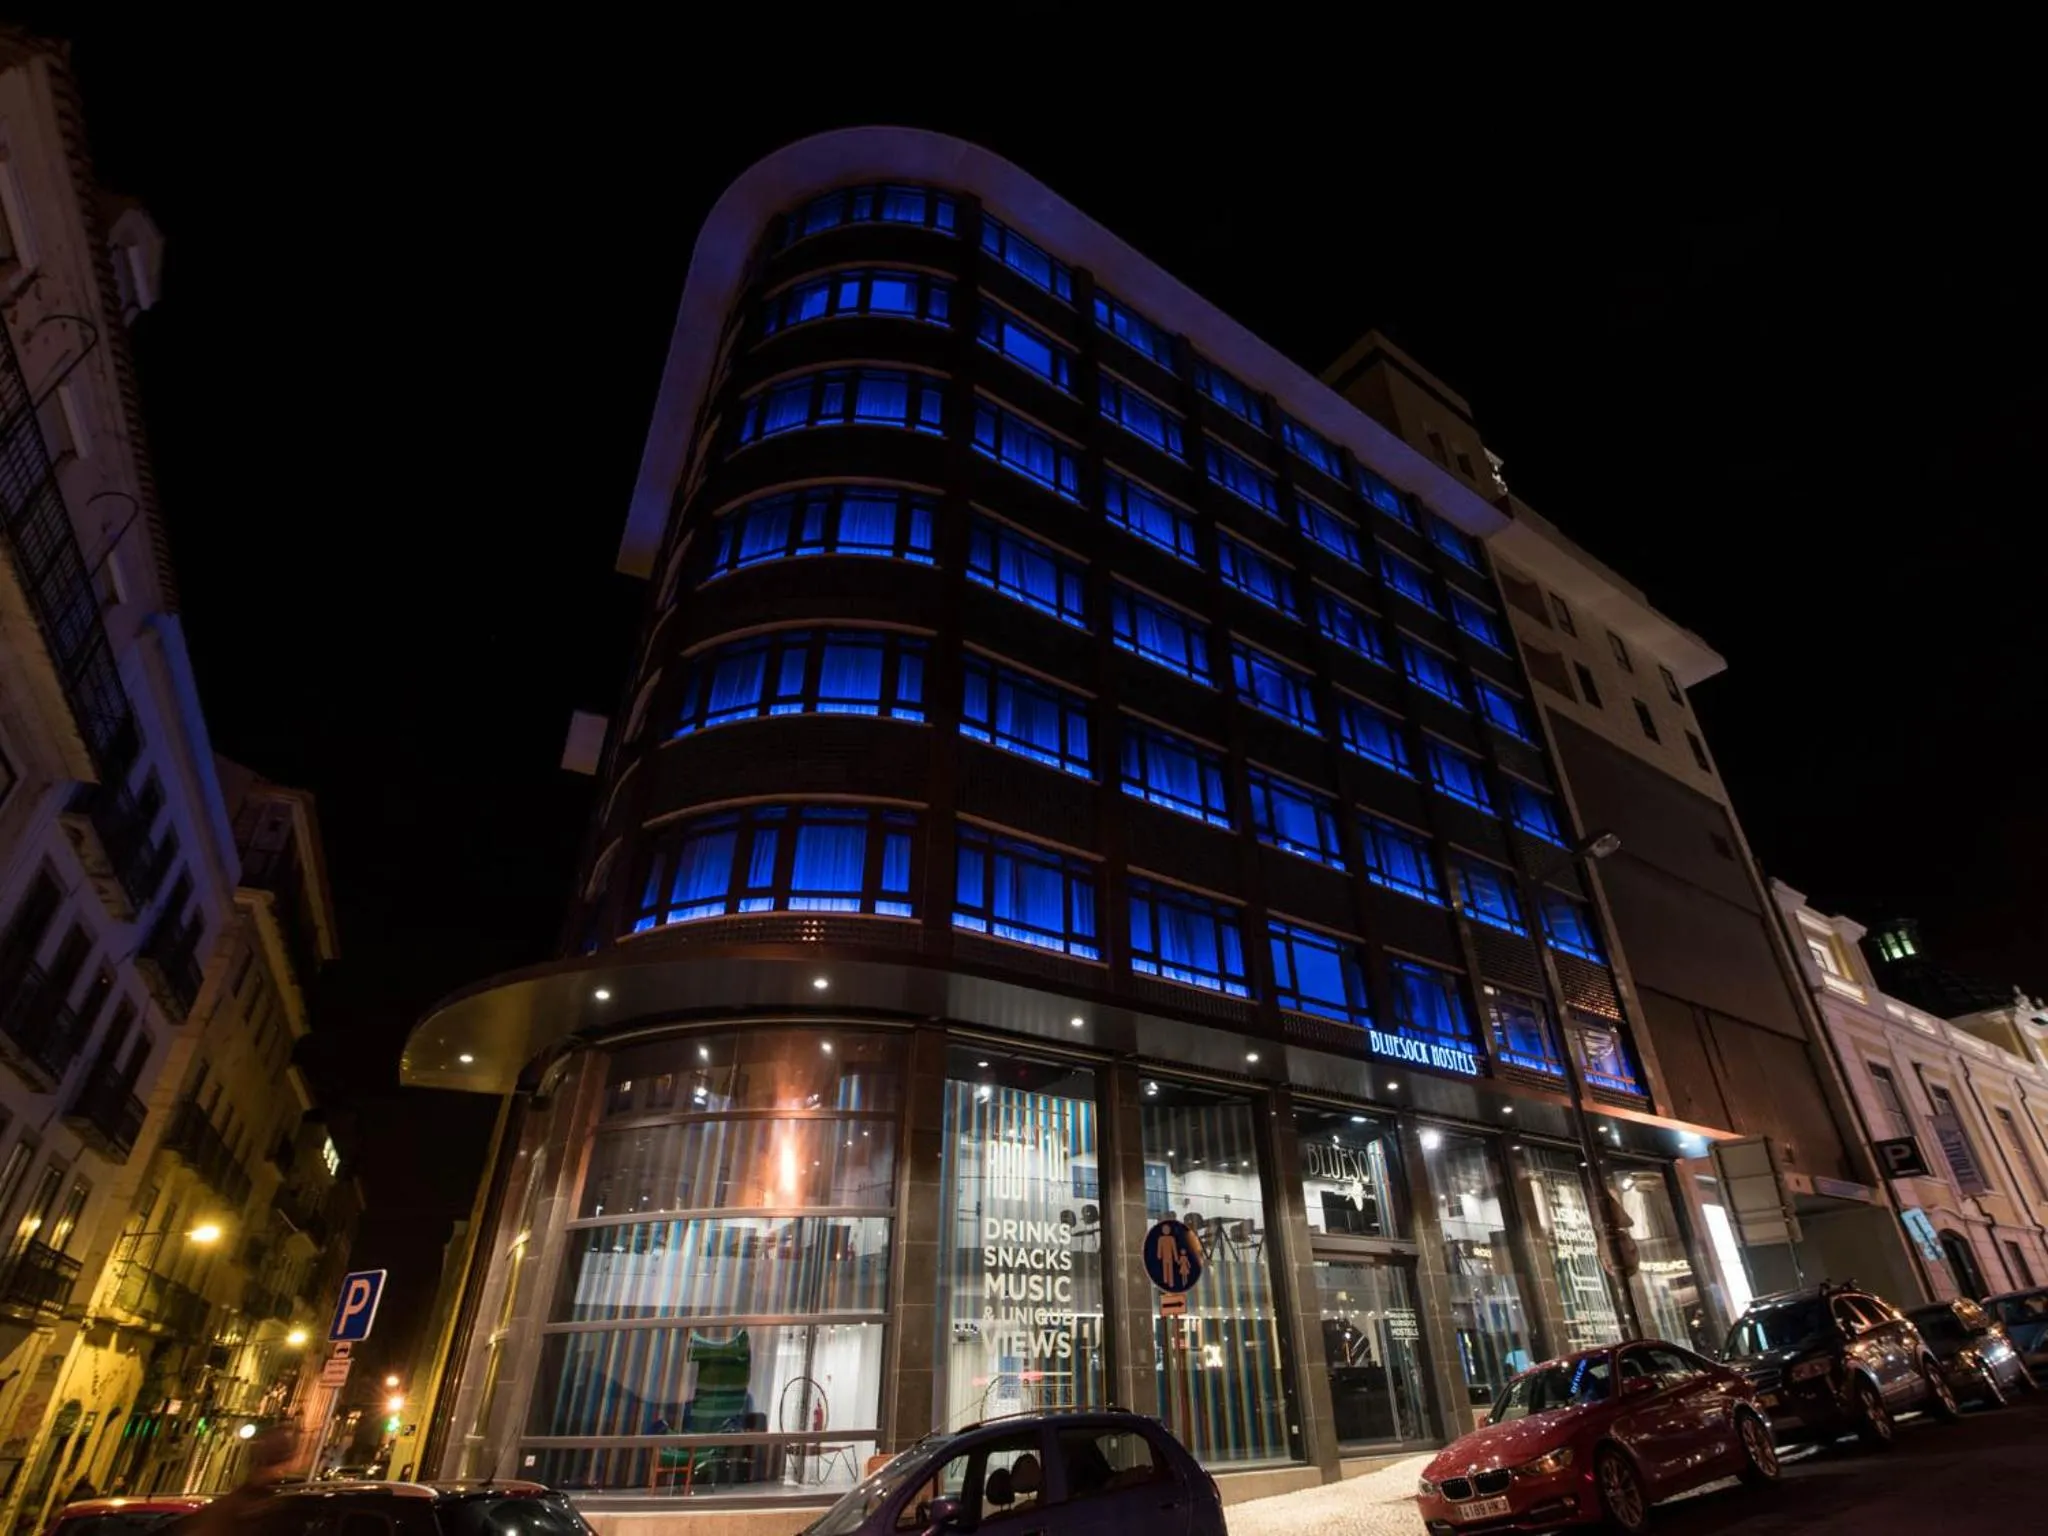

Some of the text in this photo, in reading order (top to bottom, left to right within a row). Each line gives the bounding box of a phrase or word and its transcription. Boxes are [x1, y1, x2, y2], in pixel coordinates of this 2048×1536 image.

[1370, 1030, 1477, 1075] BLUESOCK HOSTELS
[1883, 1143, 1912, 1172] P
[984, 1218, 1071, 1244] DRINKS
[984, 1246, 1072, 1270] SNACKS
[985, 1272, 1071, 1302] MUSIC
[336, 1279, 371, 1336] P
[983, 1305, 1072, 1327] & UNIQUE
[982, 1328, 1072, 1359] VIEWS
